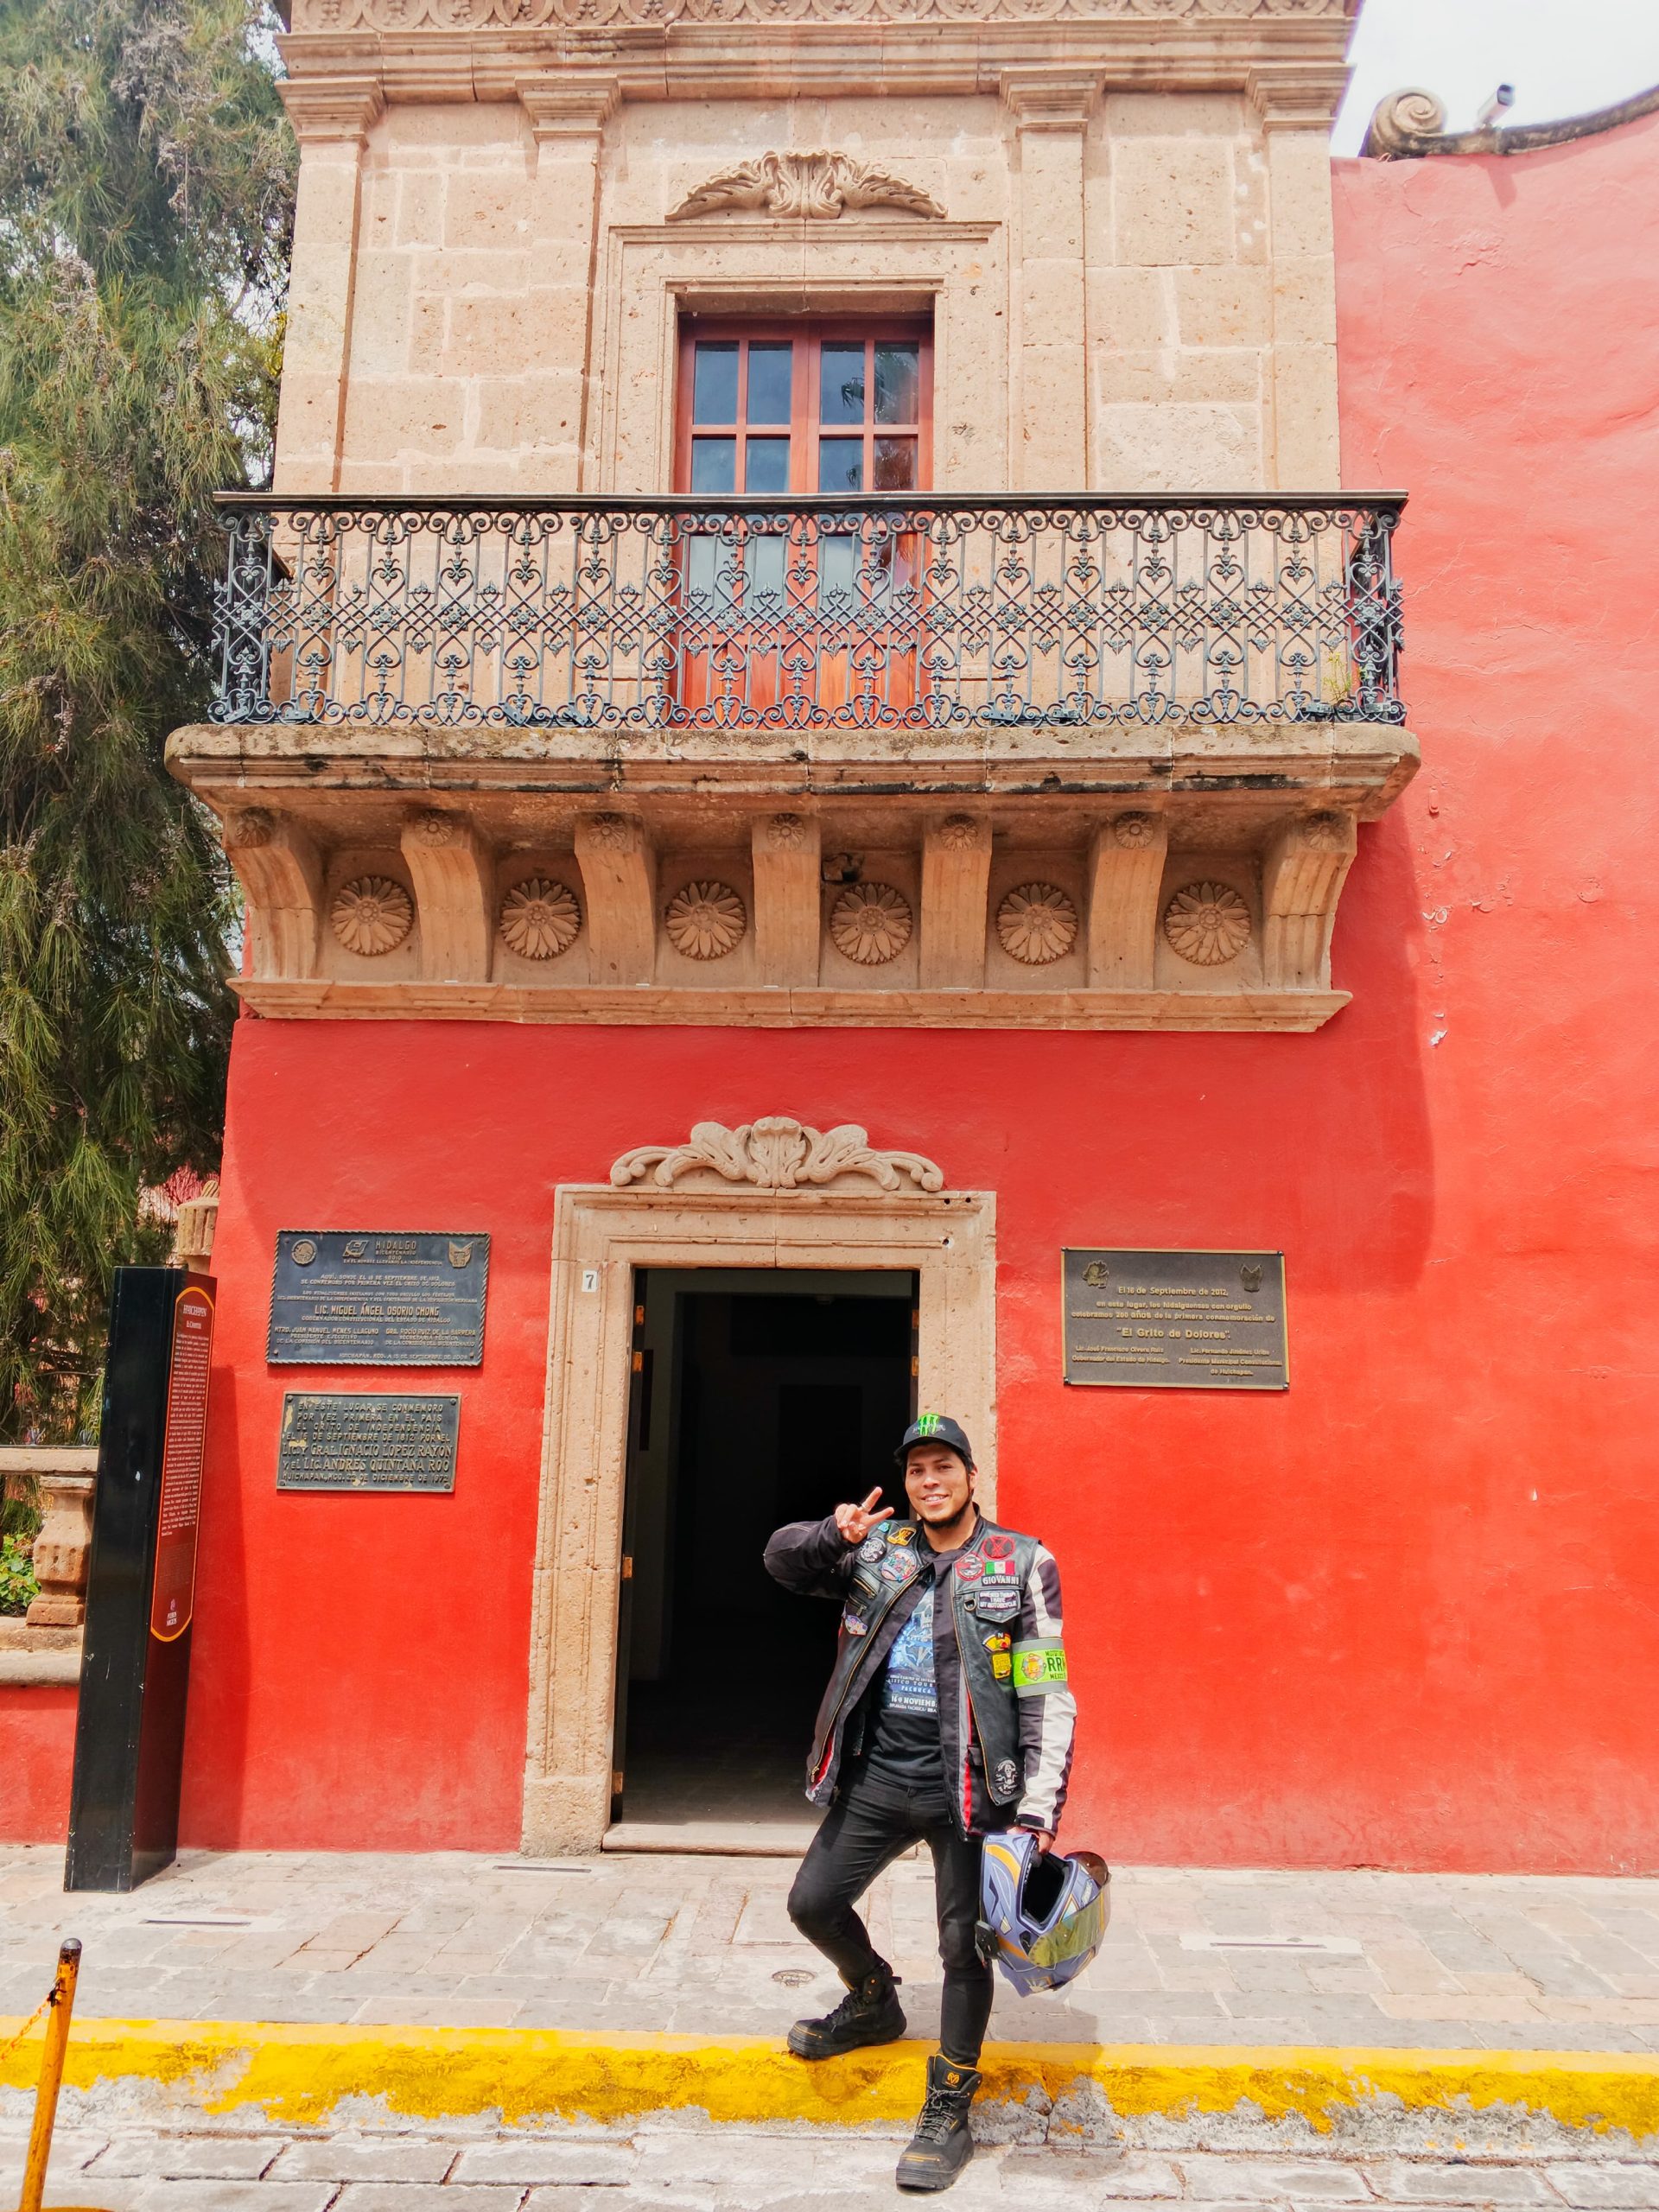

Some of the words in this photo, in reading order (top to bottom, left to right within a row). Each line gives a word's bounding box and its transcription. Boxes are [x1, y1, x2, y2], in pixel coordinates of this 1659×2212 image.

[375, 1240, 416, 1249] HIDALGO
[586, 1274, 594, 1289] 7
[1150, 1287, 1197, 1297] Septiembre
[315, 1305, 329, 1315] LIC.
[331, 1306, 357, 1316] MIGUEL
[360, 1302, 385, 1316] ÁNGEL
[387, 1306, 414, 1316] OSORIO
[416, 1306, 440, 1317] CHONG
[1163, 1301, 1210, 1311] hidalguenses
[1226, 1303, 1252, 1312] orgullo
[1131, 1310, 1153, 1319] años
[1174, 1313, 1204, 1321] primera
[1205, 1313, 1263, 1322] conmemoración
[1137, 1328, 1165, 1338] Grito
[1168, 1329, 1181, 1338] de
[314, 1402, 338, 1411] ESTE
[343, 1403, 372, 1412] LUGAR
[392, 1404, 443, 1413] CONMEMORO
[297, 1413, 315, 1421] POR
[321, 1413, 338, 1422] VEZ
[343, 1413, 382, 1422] PRIMERA
[388, 1414, 399, 1422] EN
[405, 1414, 416, 1423] EL
[422, 1414, 442, 1423] PAIS
[296, 1422, 308, 1431] EL
[315, 1422, 341, 1432] GRITO
[348, 1423, 360, 1432] DE
[366, 1424, 441, 1433] INDEPENDENCIA
[286, 1432, 296, 1440] EL
[313, 1433, 323, 1441] DE
[327, 1433, 379, 1442] SEPTIEMBRE
[383, 1433, 393, 1442] DE
[397, 1433, 416, 1442] 1812
[420, 1434, 436, 1443] POR
[441, 1434, 451, 1443] EL
[339, 1443, 380, 1457] IGNACIO
[382, 1444, 416, 1458] LOPEZ
[417, 1445, 453, 1459] RAYON
[323, 1458, 366, 1471] ANDRES
[371, 1459, 424, 1472] QUINTANA
[429, 1460, 450, 1472] ROO
[372, 1474, 415, 1483] DICIEMBRE
[418, 1474, 429, 1483] DE
[432, 1474, 449, 1484] 1972
[982, 1575, 1020, 1585] GIOVANNI
[988, 1600, 1017, 1609] MOTORCYCLE
